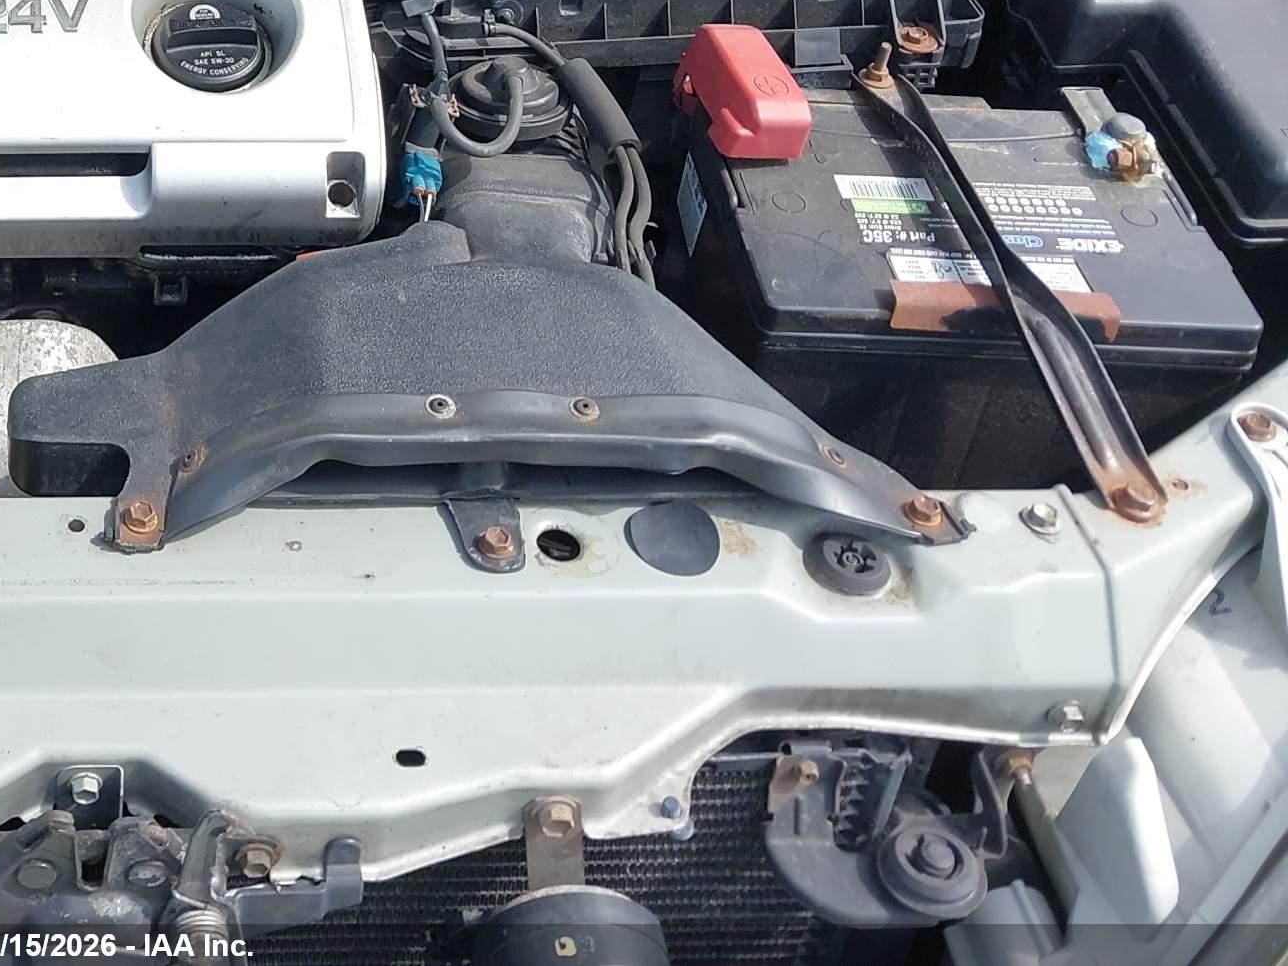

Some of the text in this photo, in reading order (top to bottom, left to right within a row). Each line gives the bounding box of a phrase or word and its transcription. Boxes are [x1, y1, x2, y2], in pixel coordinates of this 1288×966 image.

[180, 57, 250, 76] ENERGY CONSERVING
[211, 57, 234, 65] 5W-30
[862, 230, 893, 243] 35C
[910, 231, 935, 242] Part
[1001, 234, 1122, 253] EXIDE Clas
